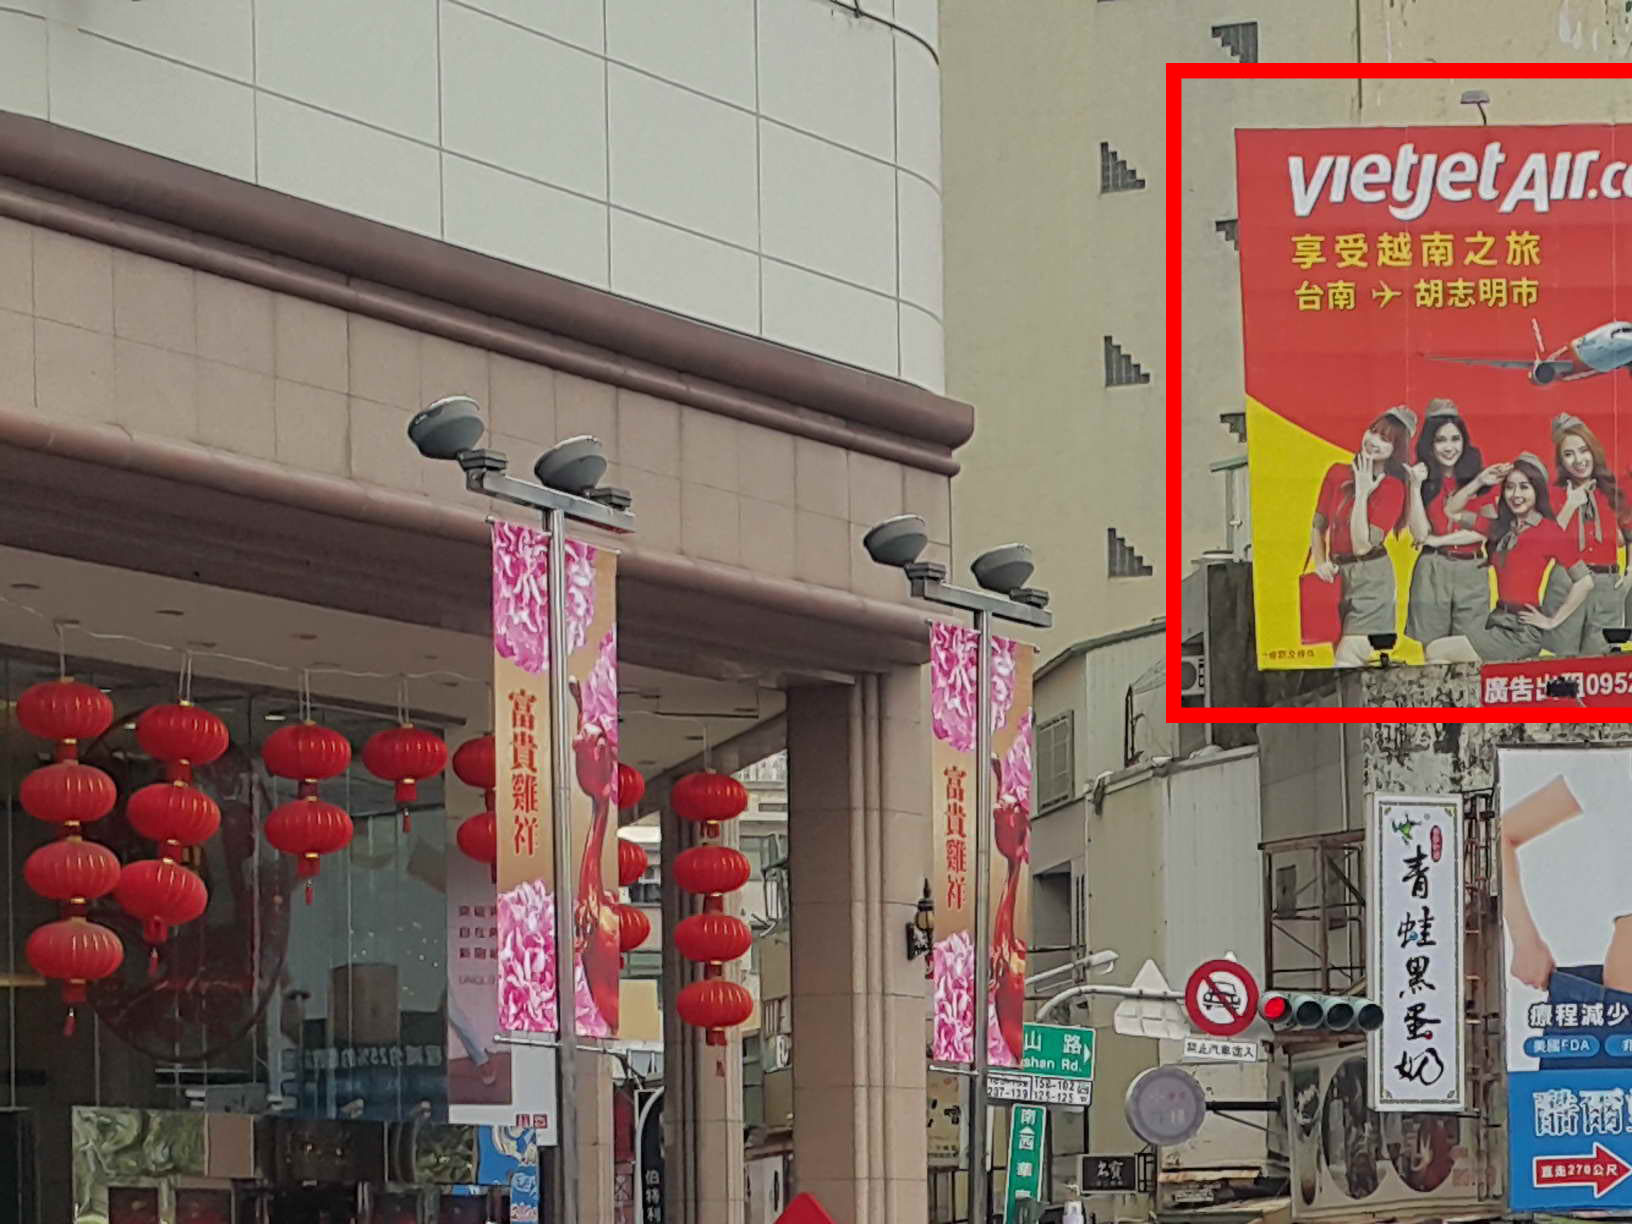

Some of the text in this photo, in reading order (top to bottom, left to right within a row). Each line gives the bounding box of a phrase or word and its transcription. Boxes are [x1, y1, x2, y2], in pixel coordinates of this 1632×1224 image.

[1291, 230, 1541, 270] 享受越南之旅
[1294, 276, 1539, 311] 台南 胡志明市
[1021, 1056, 1082, 1072] shan Rd.
